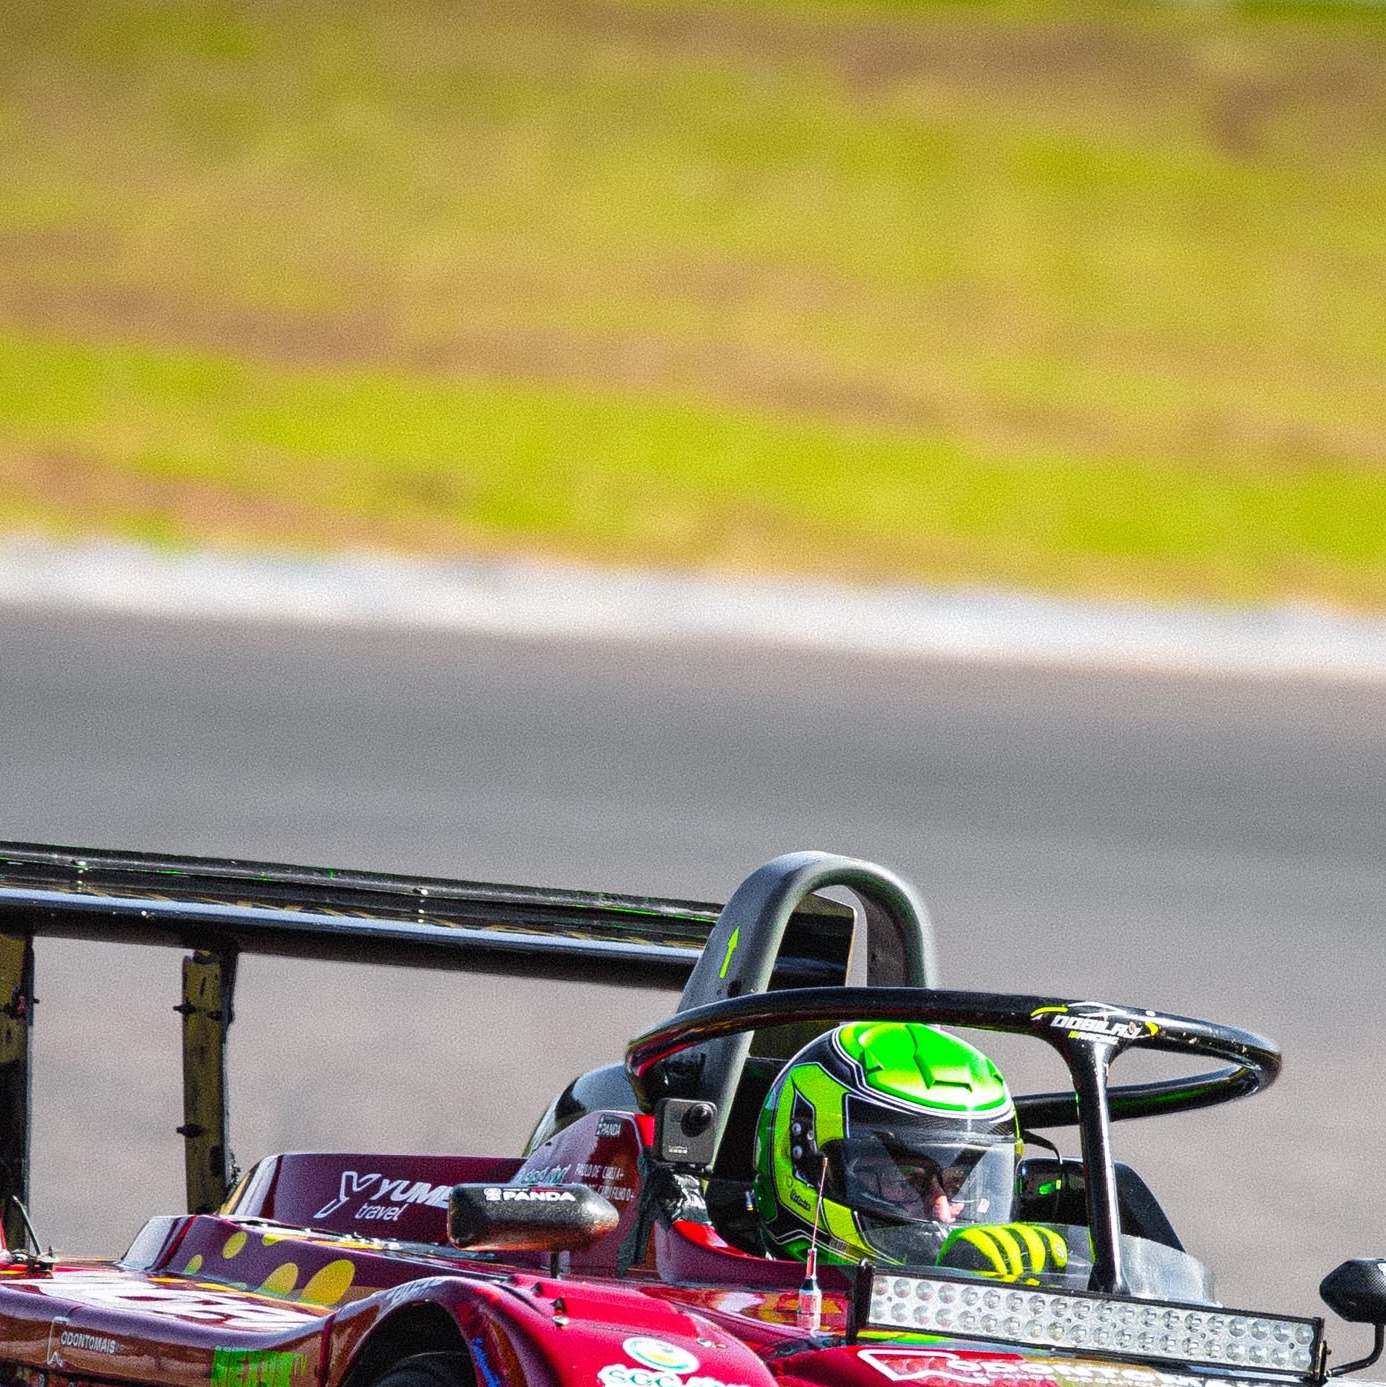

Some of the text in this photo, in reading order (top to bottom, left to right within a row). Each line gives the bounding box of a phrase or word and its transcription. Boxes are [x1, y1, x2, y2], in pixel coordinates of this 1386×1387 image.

[503, 1190, 576, 1201] PANDA
[355, 1202, 409, 1222] travel
[60, 1331, 116, 1353] ODONTOMAIS
